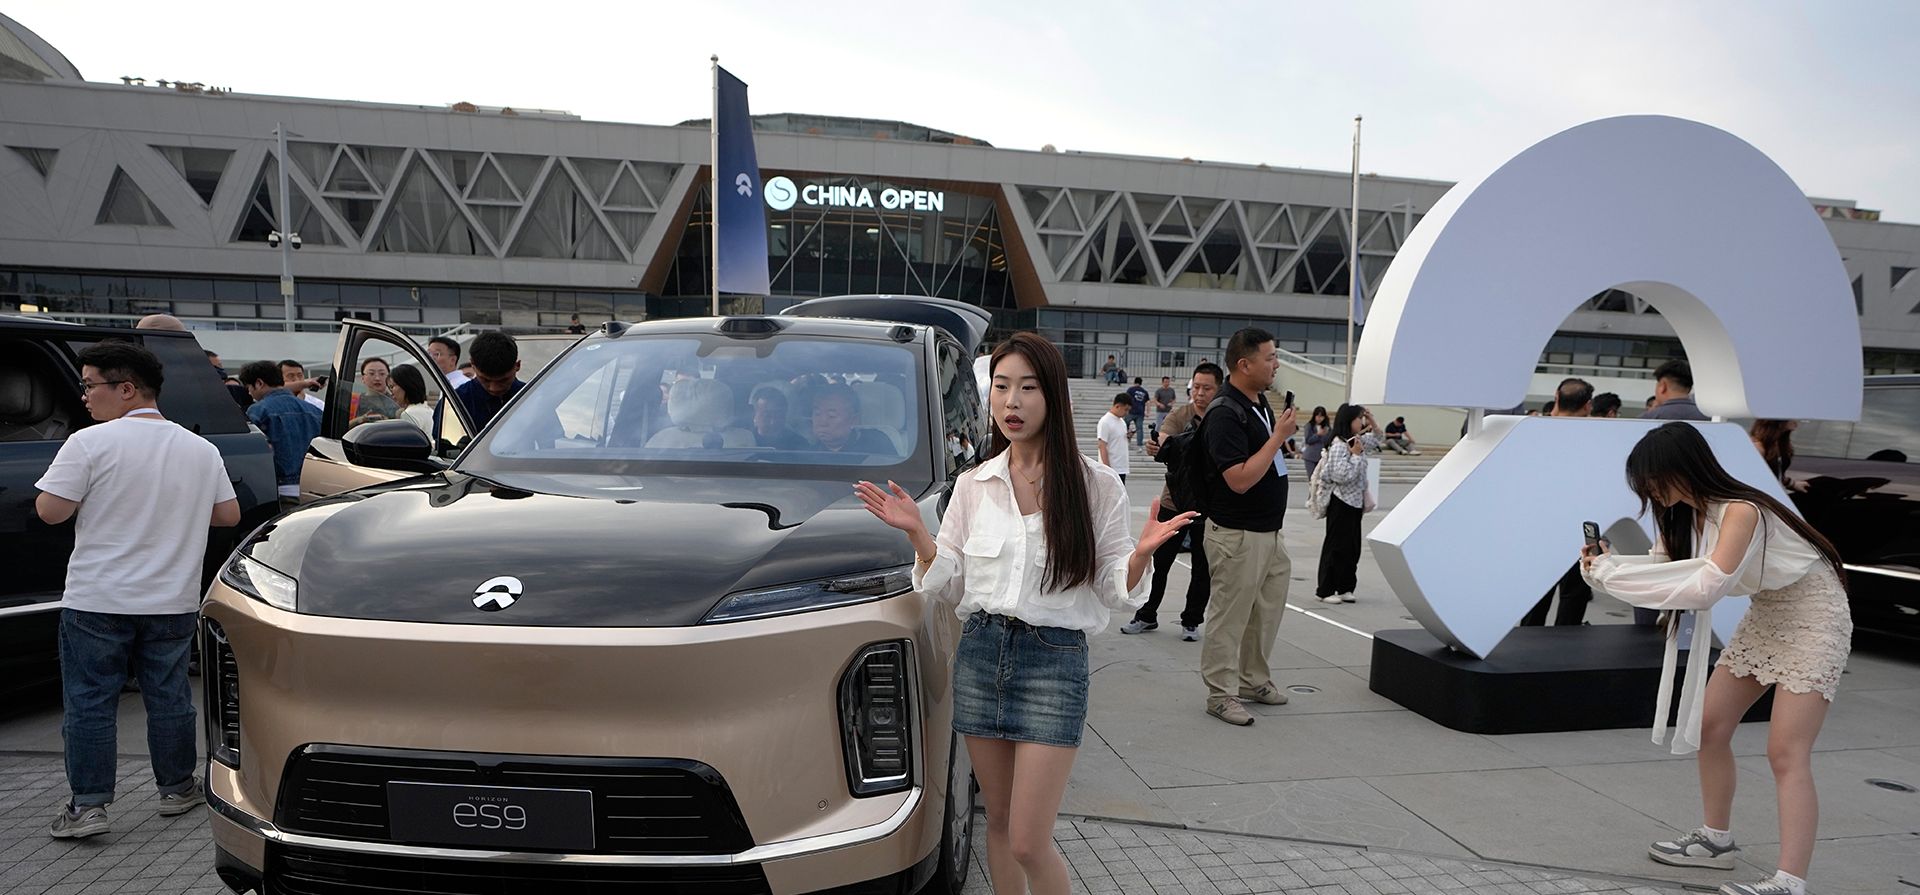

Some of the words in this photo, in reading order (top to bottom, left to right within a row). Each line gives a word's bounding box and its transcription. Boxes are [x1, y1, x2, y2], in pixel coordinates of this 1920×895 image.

[802, 184, 875, 208] CHINA
[880, 188, 944, 212] OPEN
[468, 795, 509, 803] HORIZON
